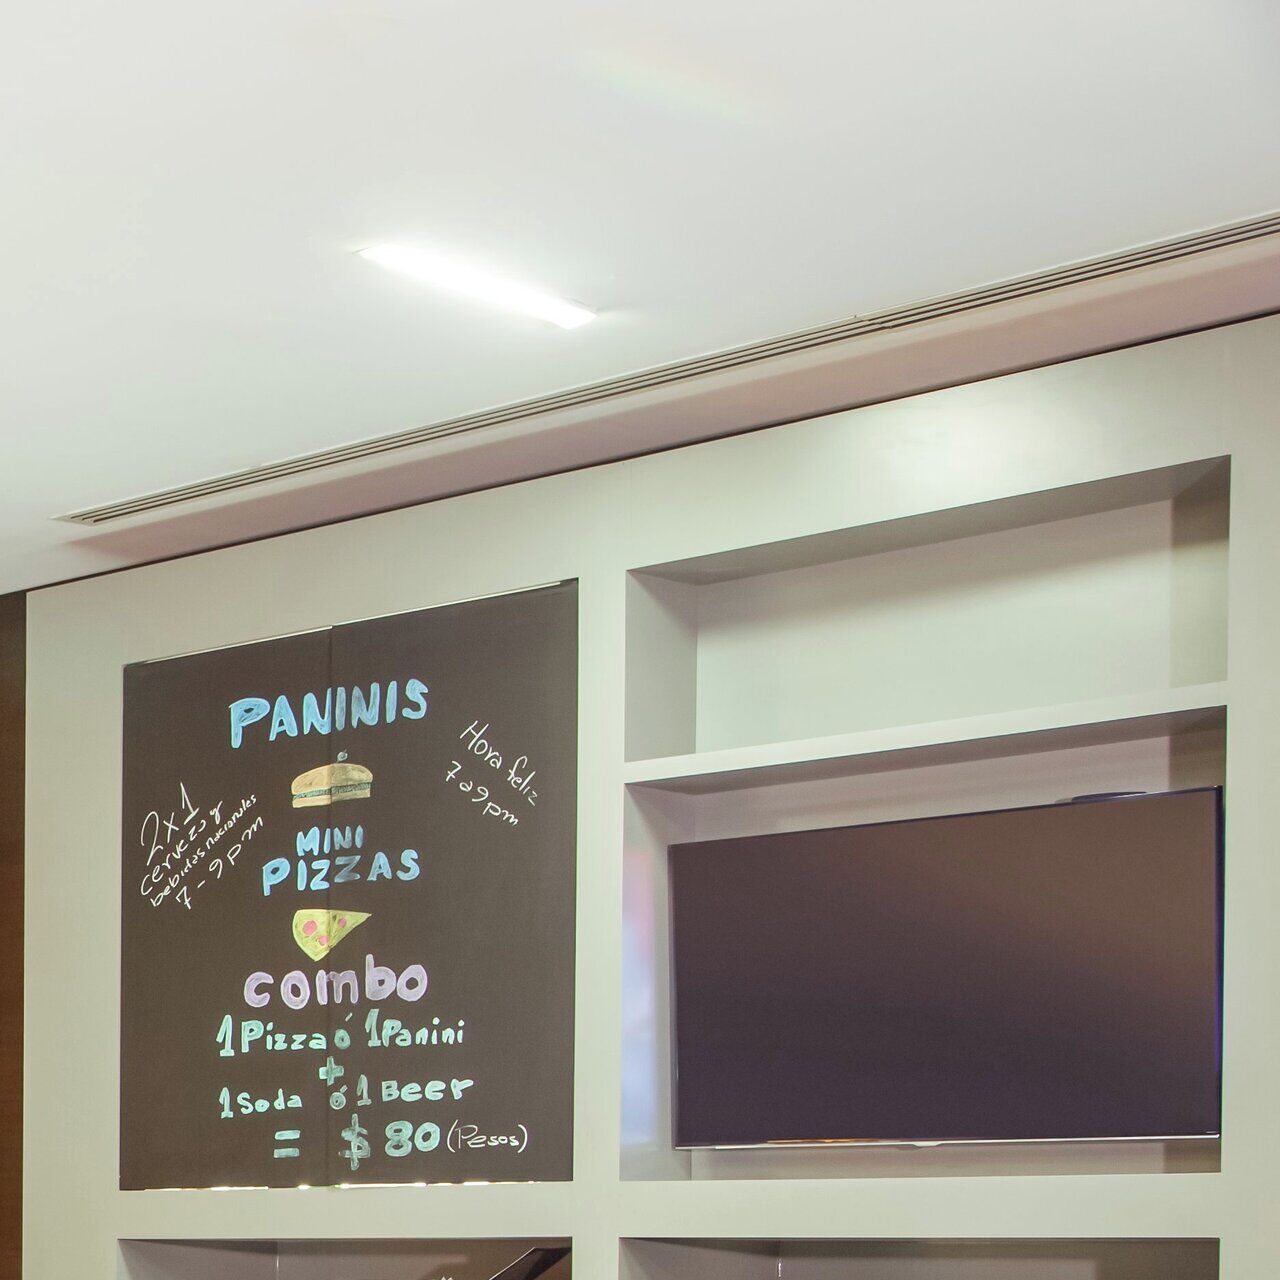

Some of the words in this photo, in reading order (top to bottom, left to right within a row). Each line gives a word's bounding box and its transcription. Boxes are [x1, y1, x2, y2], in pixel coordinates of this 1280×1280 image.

[229, 678, 429, 749] PANINIS
[459, 720, 502, 770] Hora
[507, 755, 538, 807] feliz
[296, 824, 364, 857] MINI
[262, 848, 421, 896] PIZZAS
[446, 1119, 528, 1153] (Pesos)
